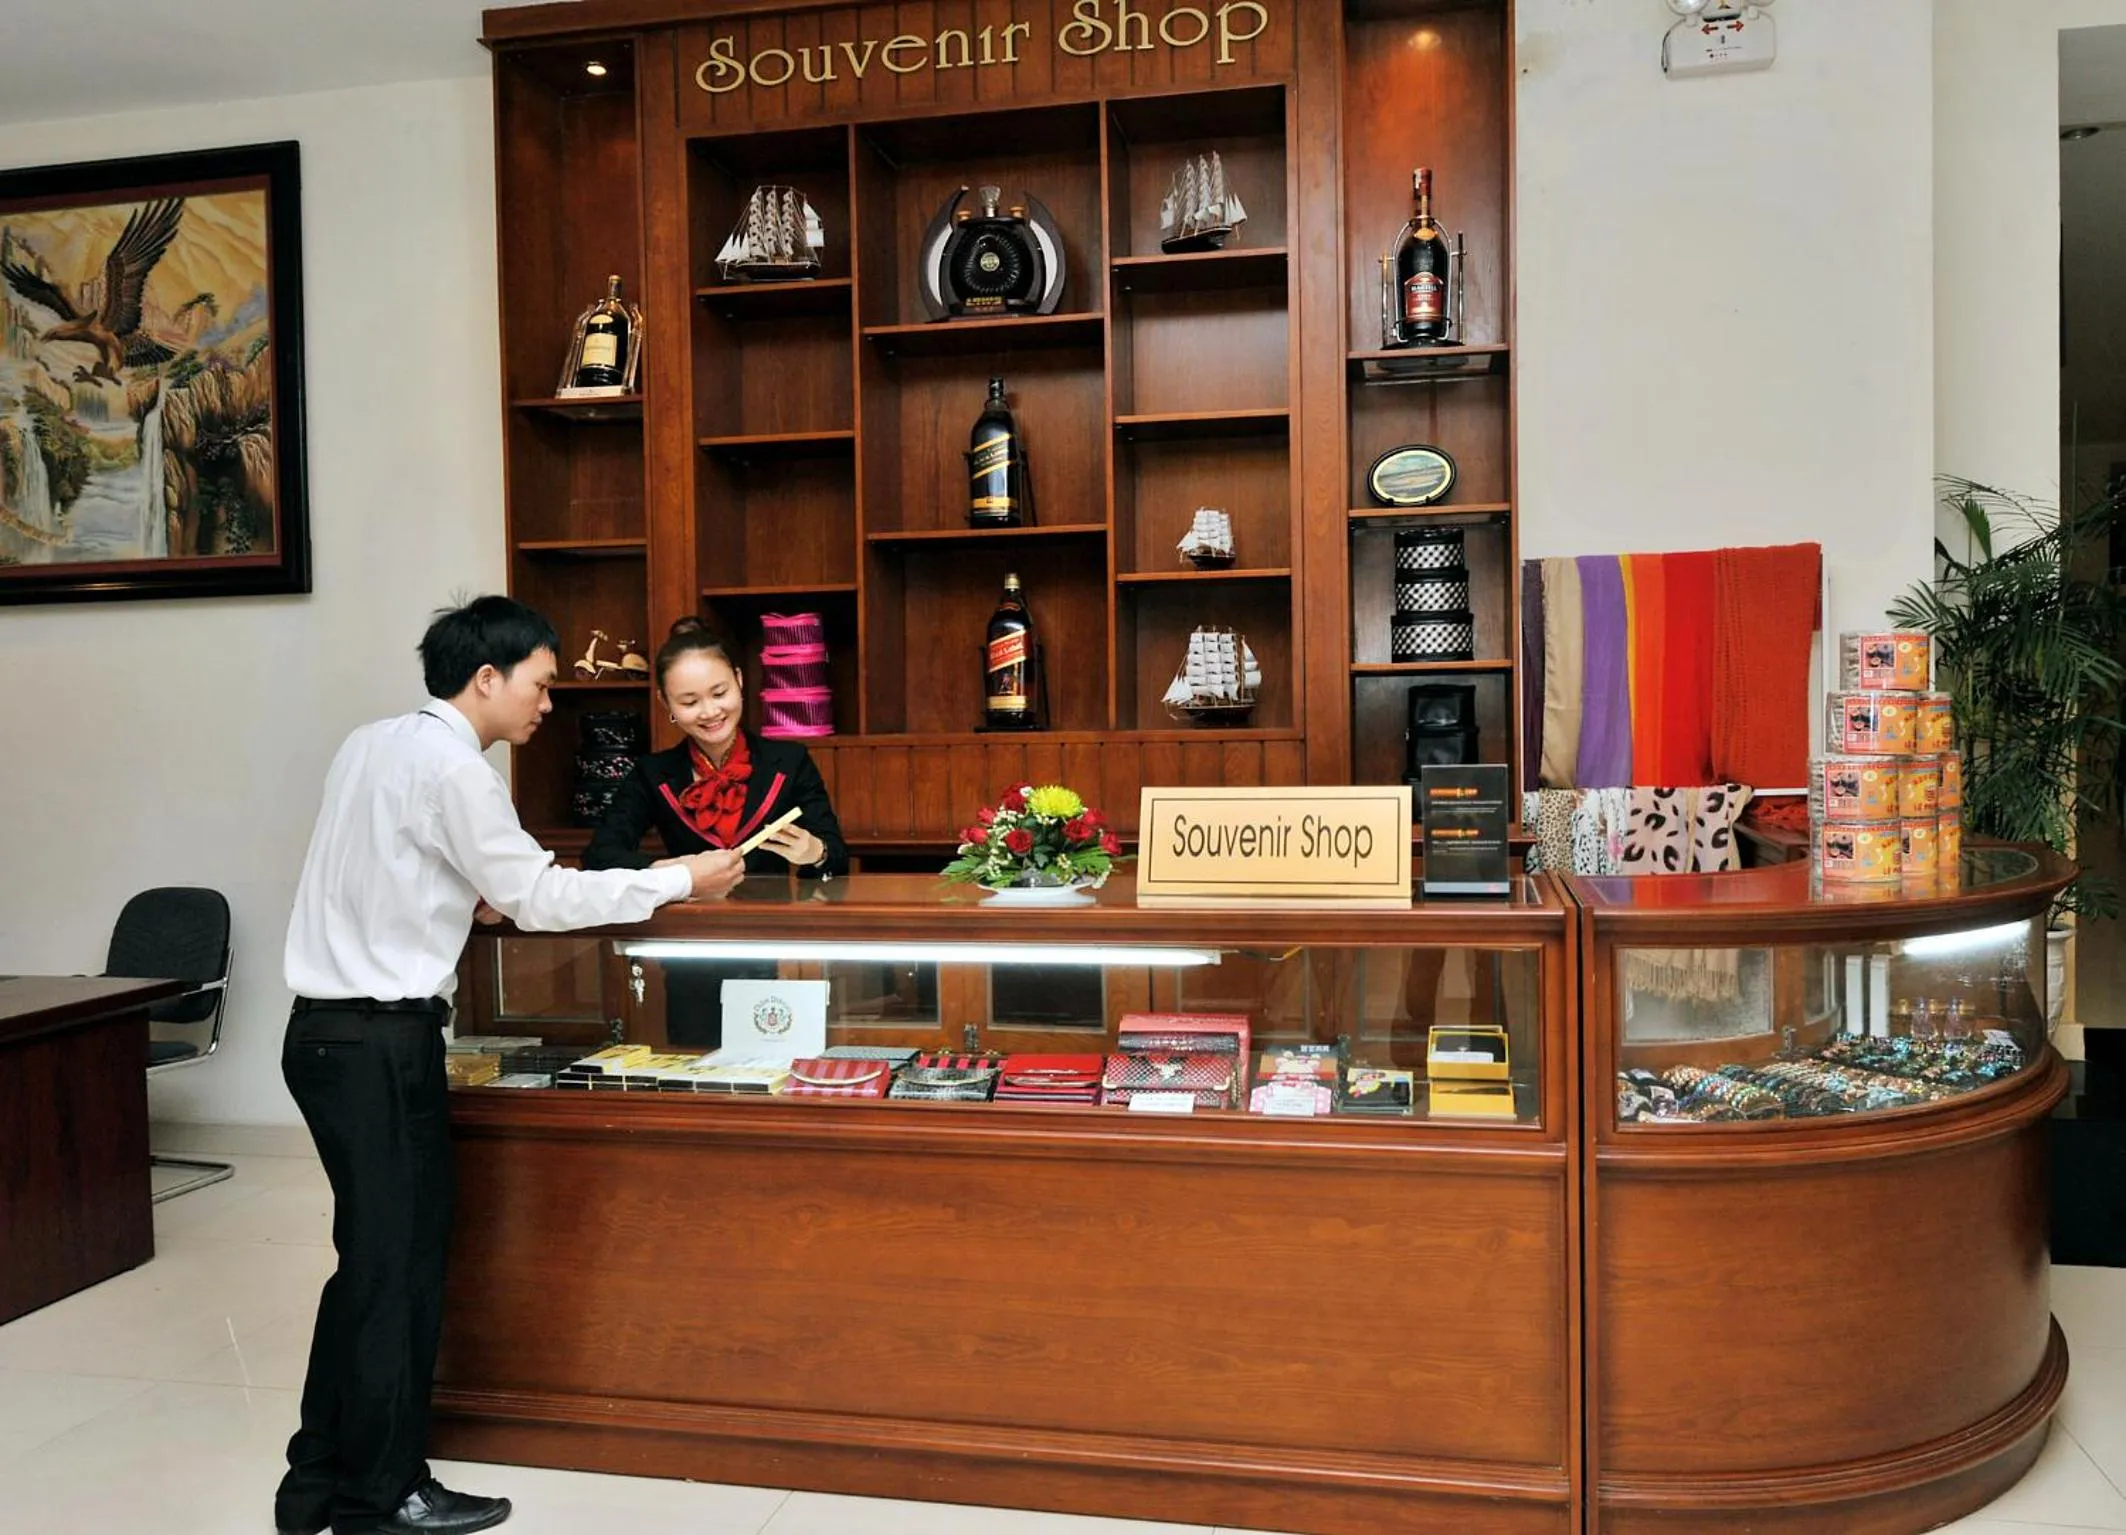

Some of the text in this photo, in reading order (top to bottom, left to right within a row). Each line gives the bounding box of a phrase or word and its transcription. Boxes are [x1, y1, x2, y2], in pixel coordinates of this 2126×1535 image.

[695, 0, 1268, 93] Souvenir Shop
[1172, 814, 1373, 868] Souvenir Shop
